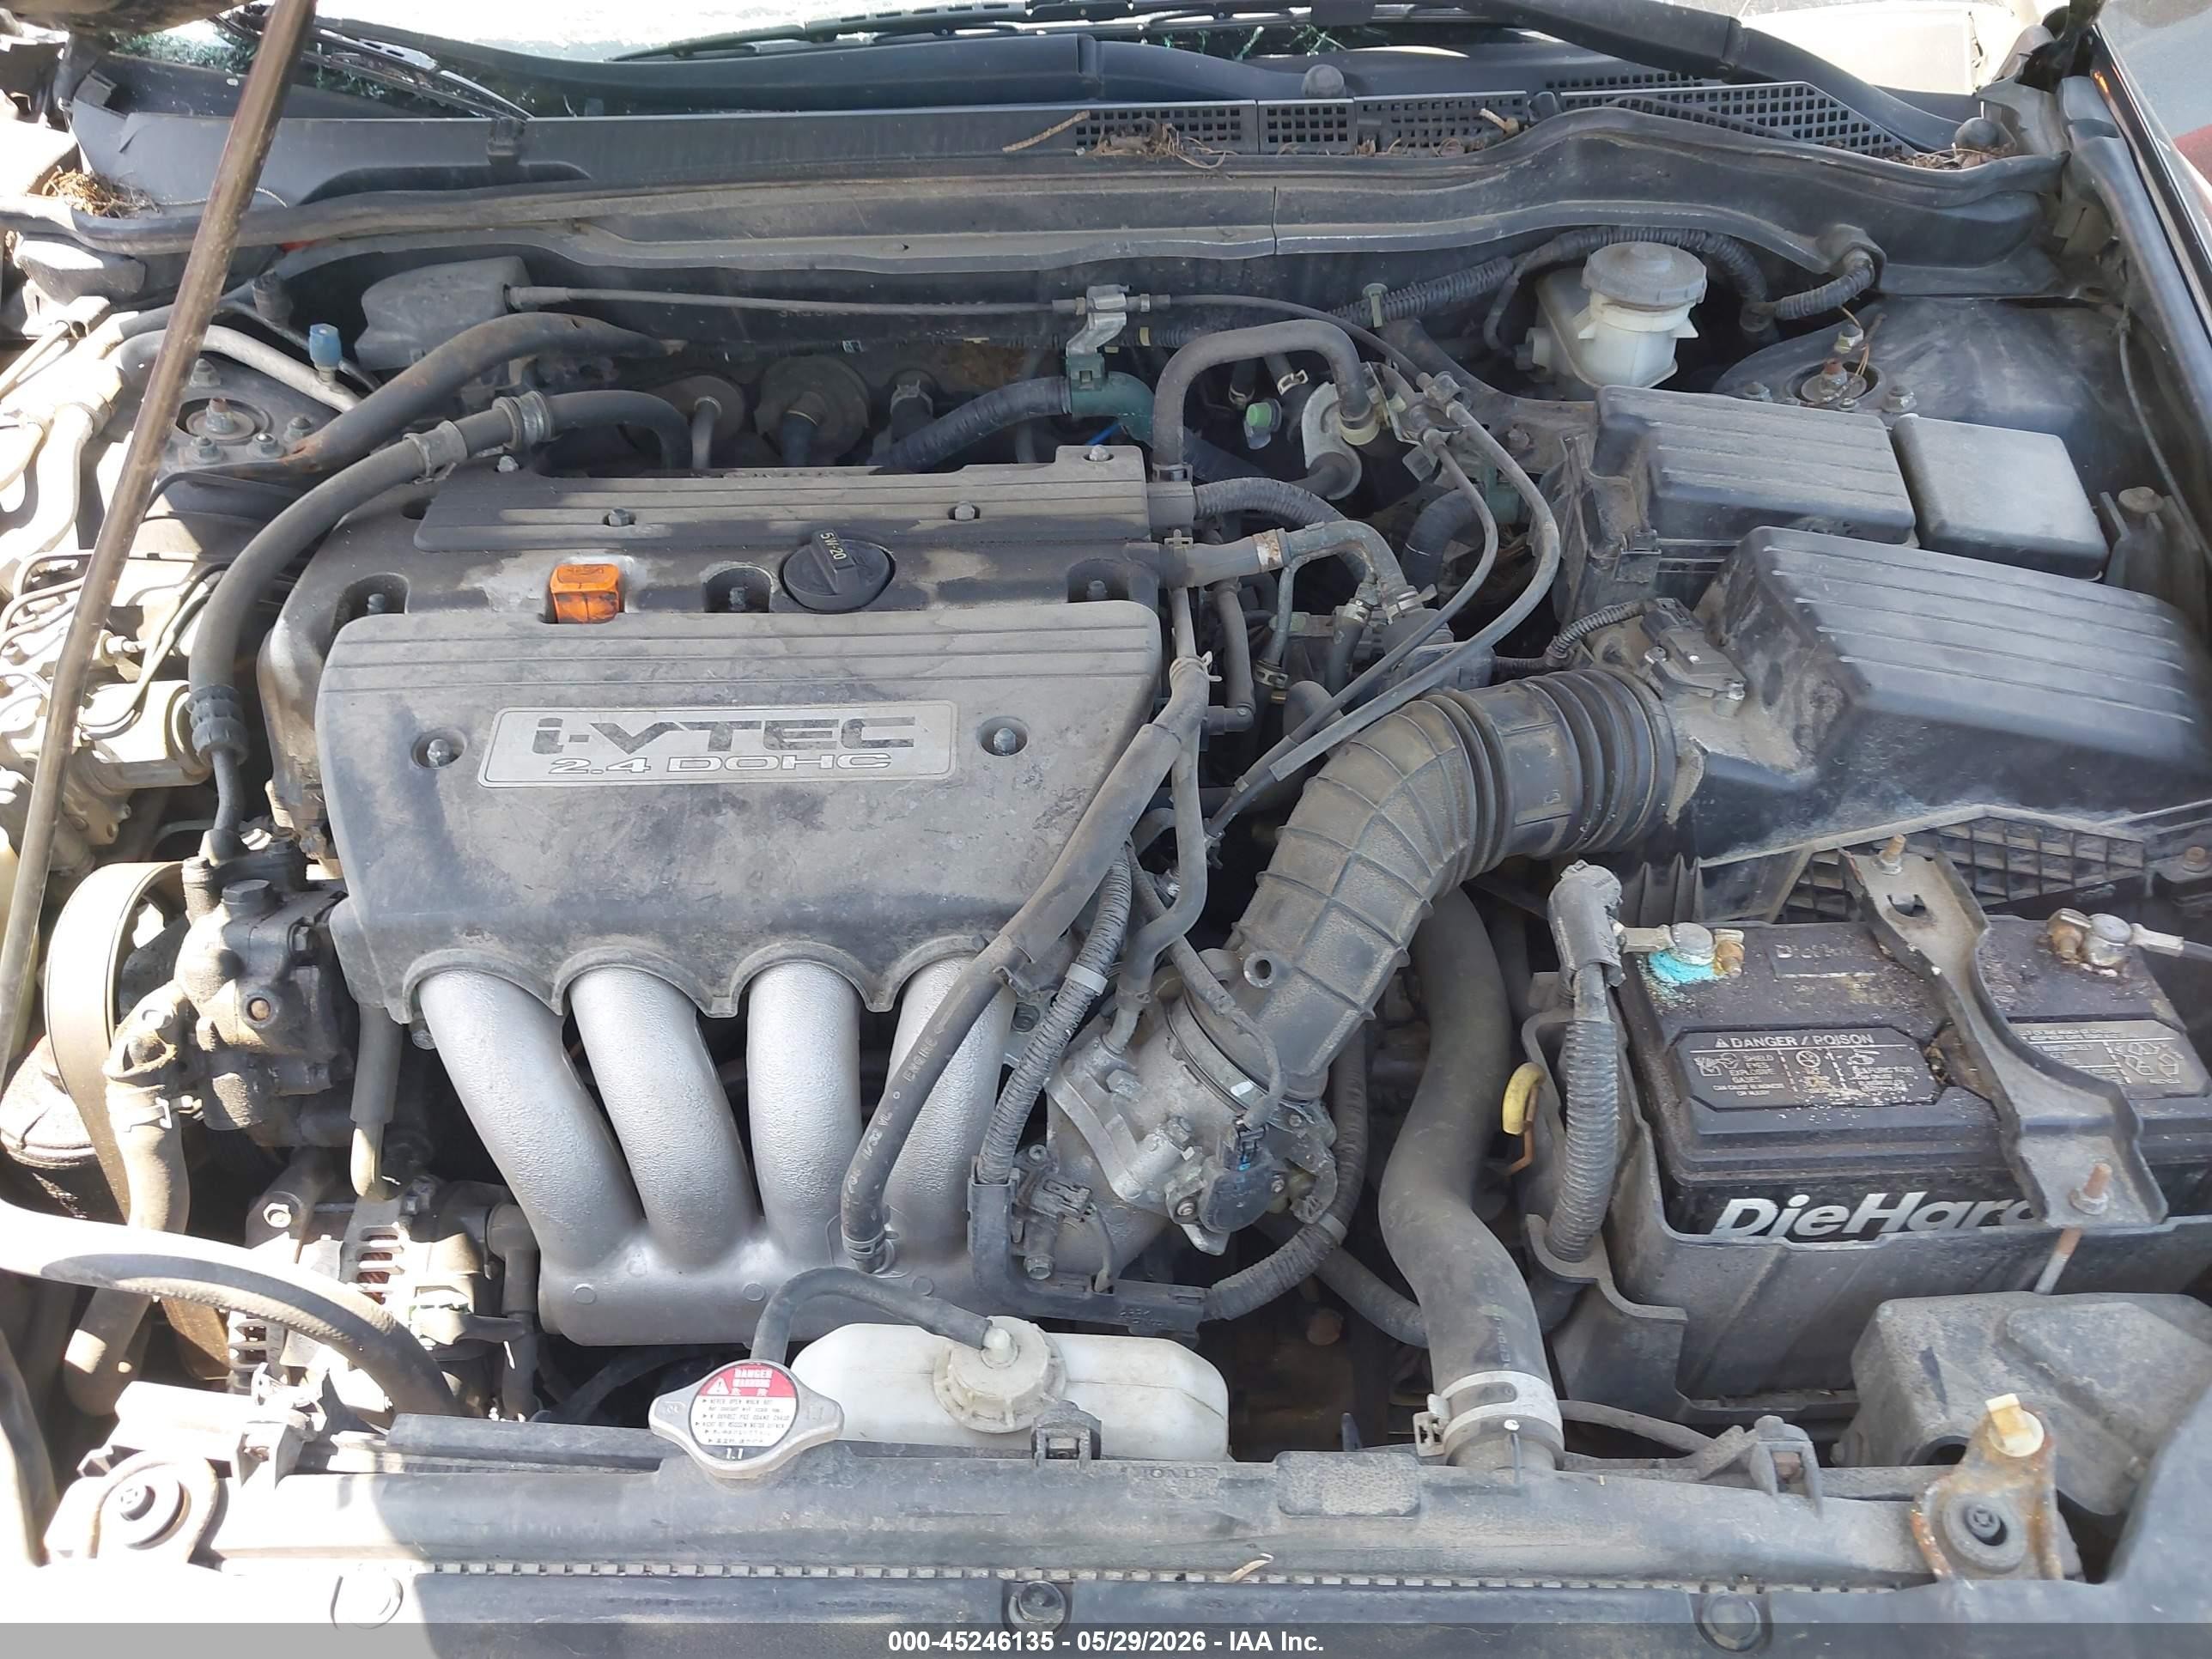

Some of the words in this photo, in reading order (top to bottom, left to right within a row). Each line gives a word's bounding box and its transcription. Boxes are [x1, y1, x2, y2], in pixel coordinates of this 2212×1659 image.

[820, 532, 847, 560] 5W-20
[532, 715, 915, 755] i-VTEC
[548, 757, 652, 775] 2.4
[667, 753, 891, 773] DOHC
[1729, 1036, 1798, 1048] DANGER
[1802, 1036, 1809, 1046] /
[1812, 1033, 1875, 1046] POISON
[726, 1448, 744, 1460] 1.1
